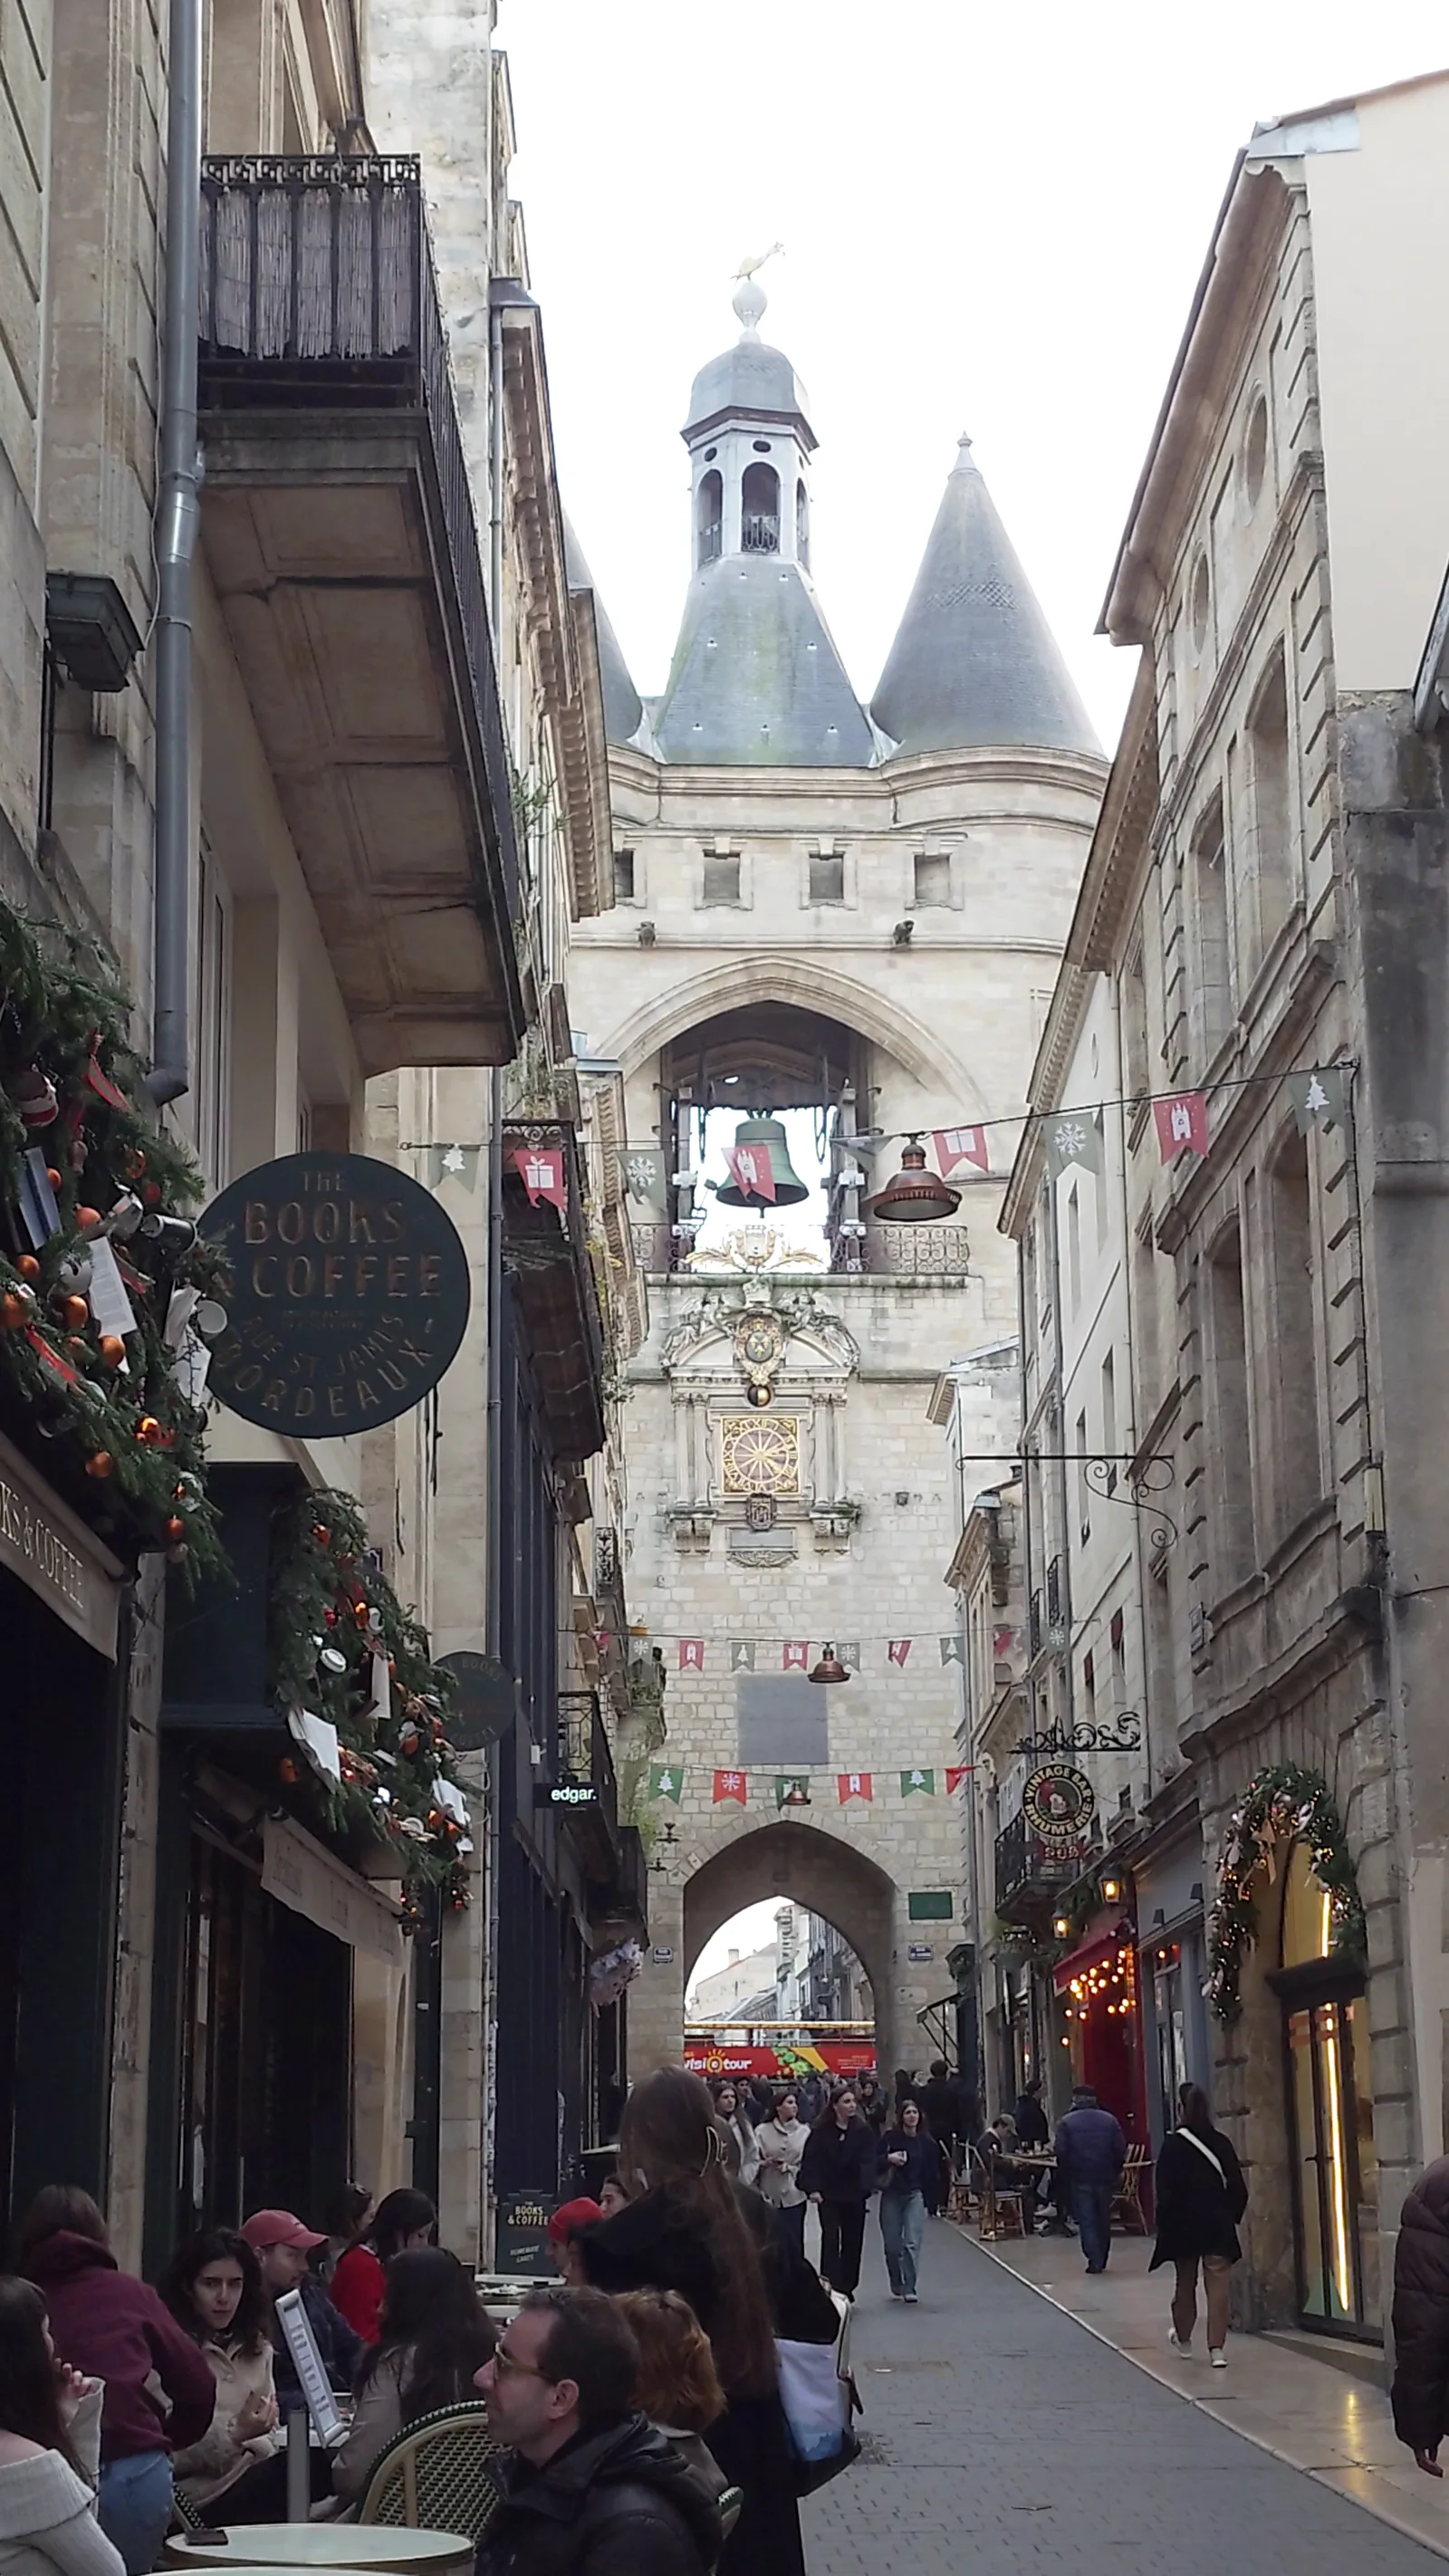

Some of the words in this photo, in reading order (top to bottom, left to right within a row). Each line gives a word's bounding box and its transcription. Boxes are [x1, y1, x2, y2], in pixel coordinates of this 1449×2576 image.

[302, 1171, 344, 1191] THE
[245, 1199, 406, 1245] BOOKS
[253, 1254, 441, 1298] COFFEE
[551, 1785, 597, 1803] edgar.
[1025, 1765, 1070, 1798] VINTAGE
[1071, 1773, 1092, 1798] BAR
[1025, 1802, 1092, 1835] RHUMERIE
[507, 2215, 514, 2225] &
[515, 2216, 549, 2225] COFFEE
[515, 2206, 543, 2216] BOOKS
